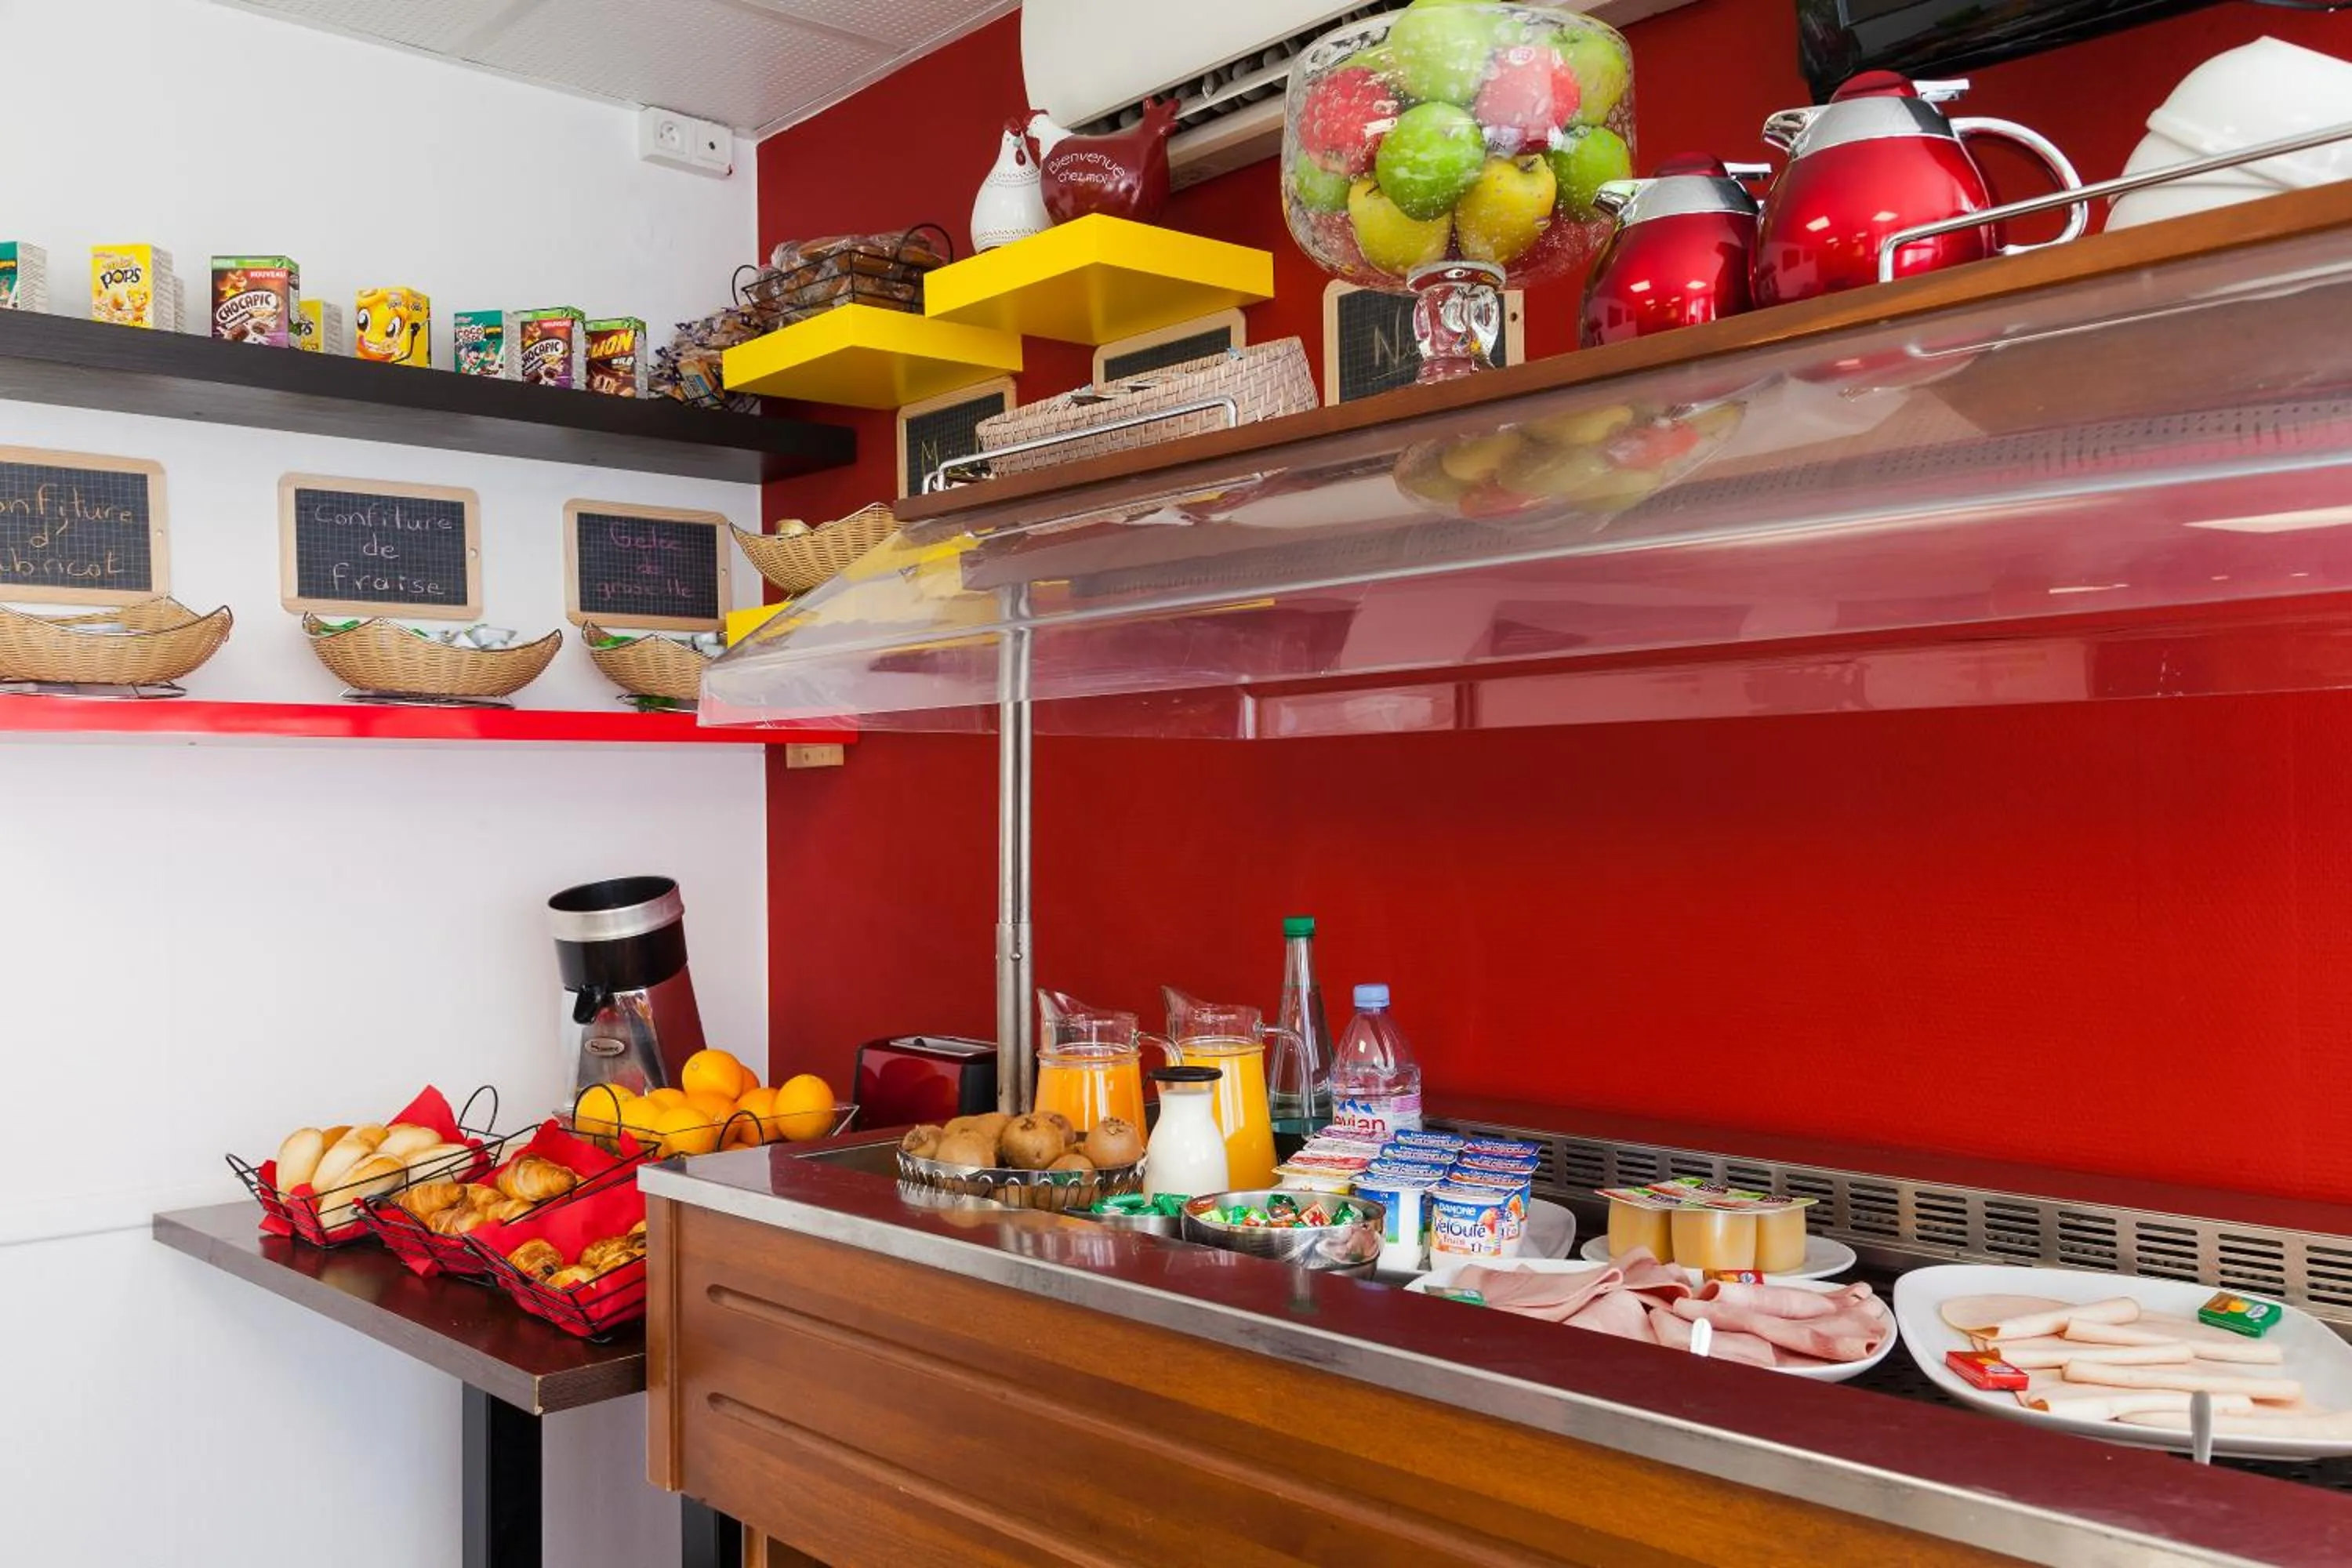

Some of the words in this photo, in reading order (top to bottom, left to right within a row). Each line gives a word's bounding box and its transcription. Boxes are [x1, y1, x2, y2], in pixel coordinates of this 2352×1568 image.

[1047, 152, 1125, 177] Bienvenue
[219, 293, 272, 321] CHOCAPIC
[521, 341, 561, 367] HOCAPIC
[590, 329, 636, 358] LION
[363, 532, 400, 559] de
[1334, 1114, 1386, 1131] evian
